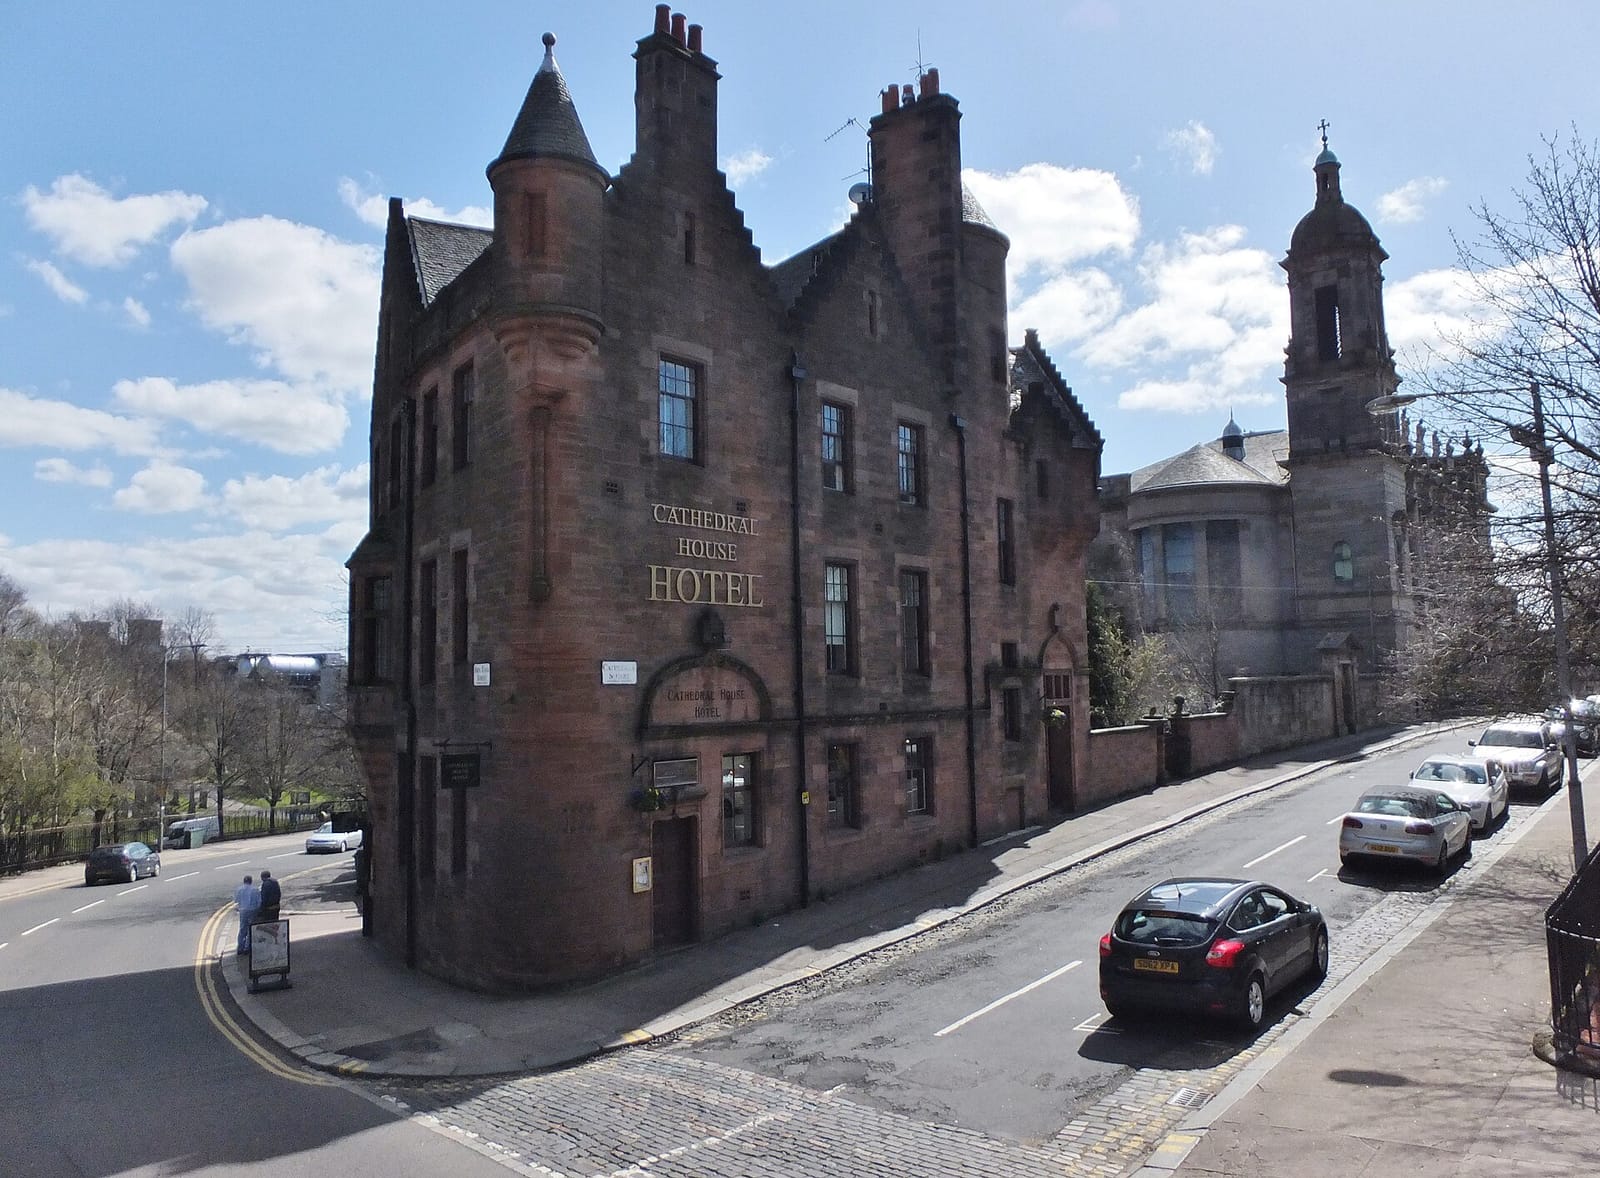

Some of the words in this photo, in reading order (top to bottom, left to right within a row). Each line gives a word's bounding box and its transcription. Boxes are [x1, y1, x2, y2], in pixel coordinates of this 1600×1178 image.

[651, 503, 760, 536] CATHEDRAL
[676, 537, 737, 561] HOUSE
[647, 565, 764, 608] HOTEL
[667, 690, 715, 701] CATHEDRAL
[720, 688, 746, 700] HOUSE
[694, 706, 722, 719] HOTEL
